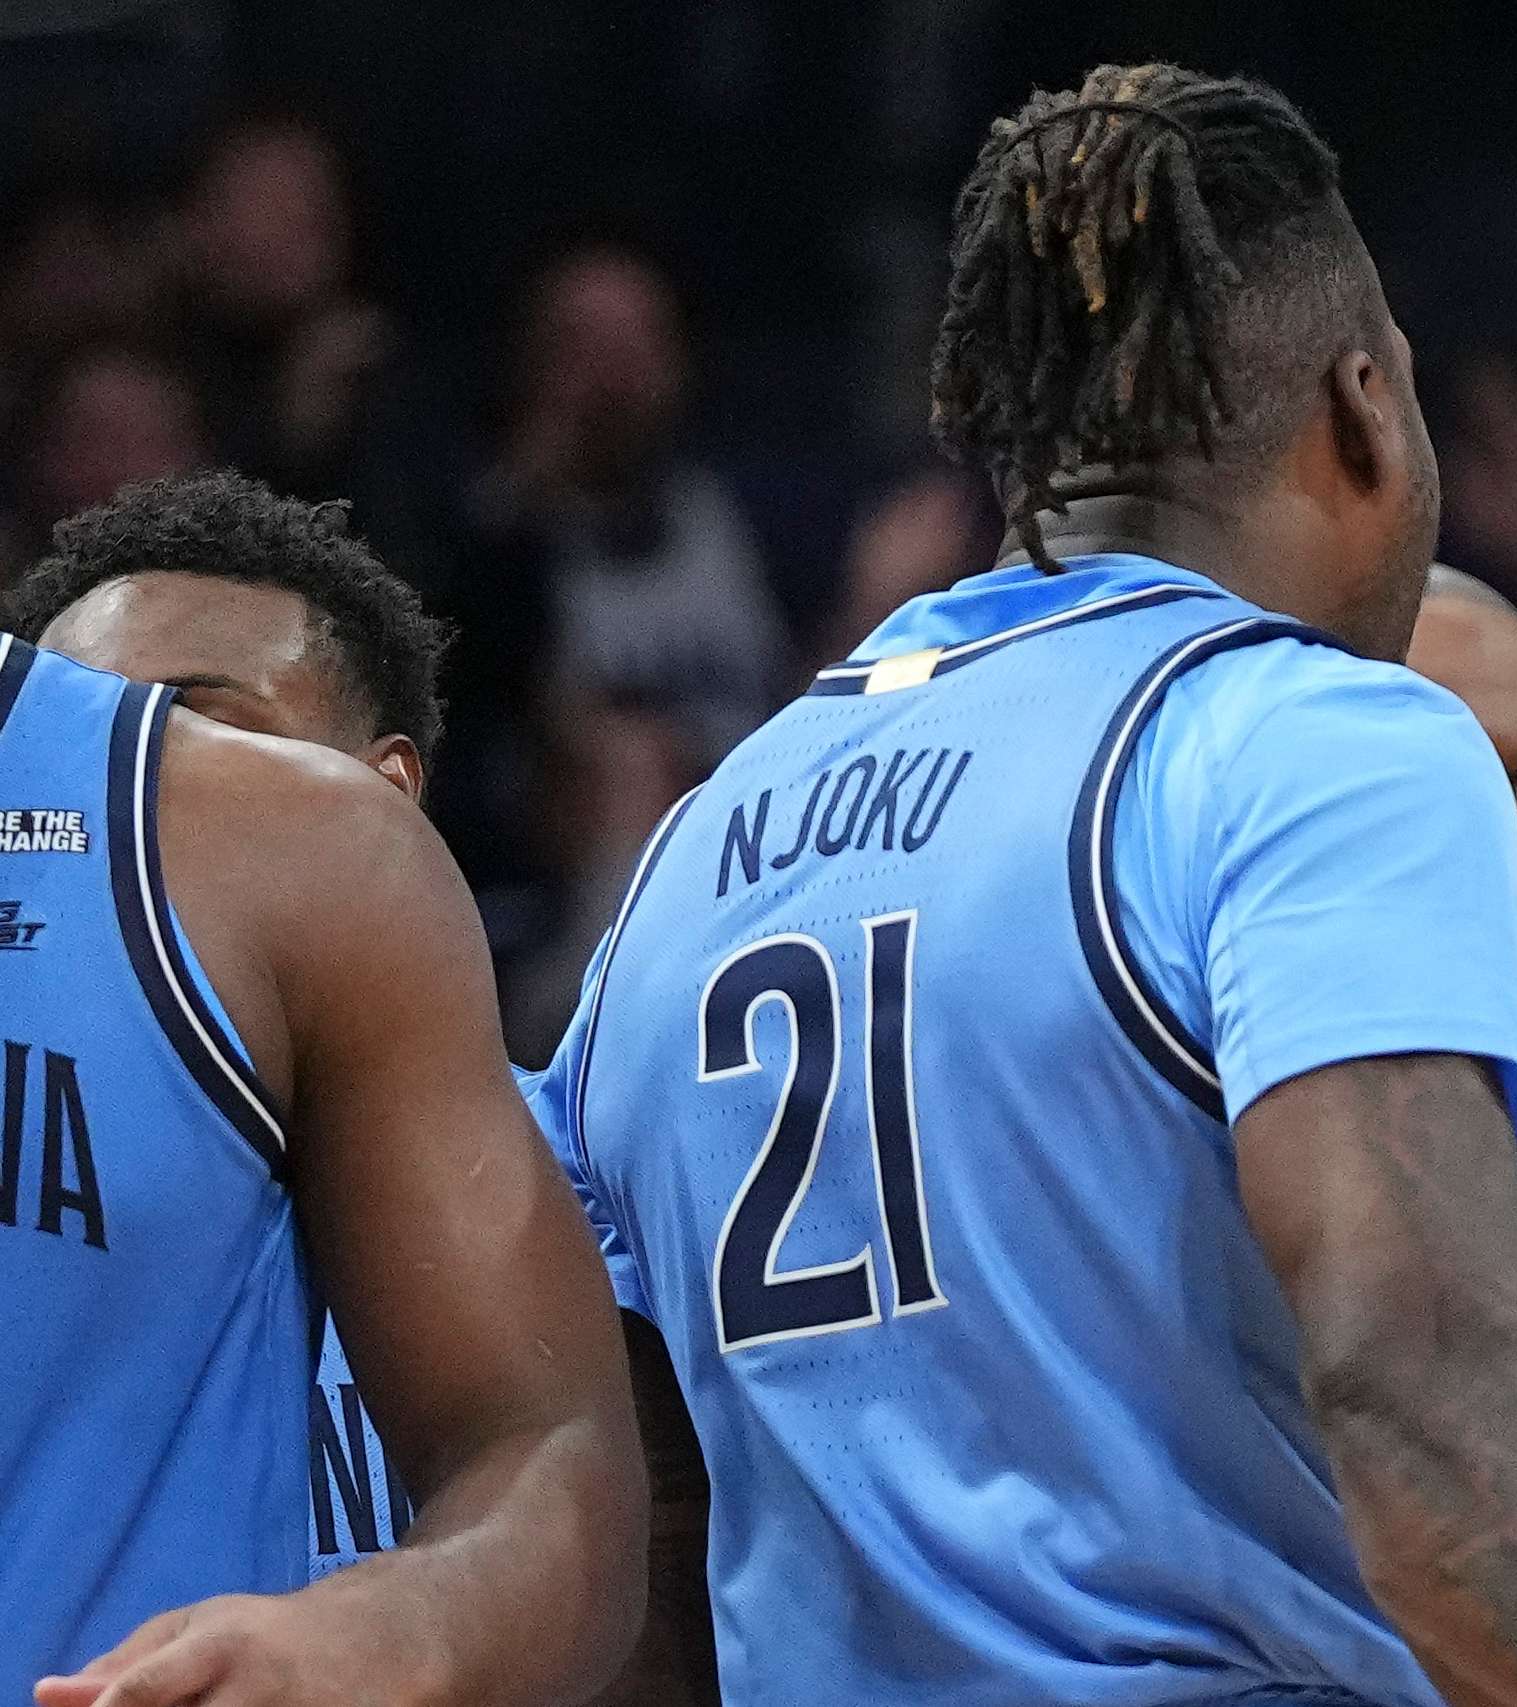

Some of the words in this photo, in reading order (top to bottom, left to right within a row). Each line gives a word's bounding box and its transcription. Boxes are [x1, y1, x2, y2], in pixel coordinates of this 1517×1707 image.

[31, 810, 83, 832] THE
[716, 748, 973, 898] NJOKU
[698, 908, 949, 1353] 21
